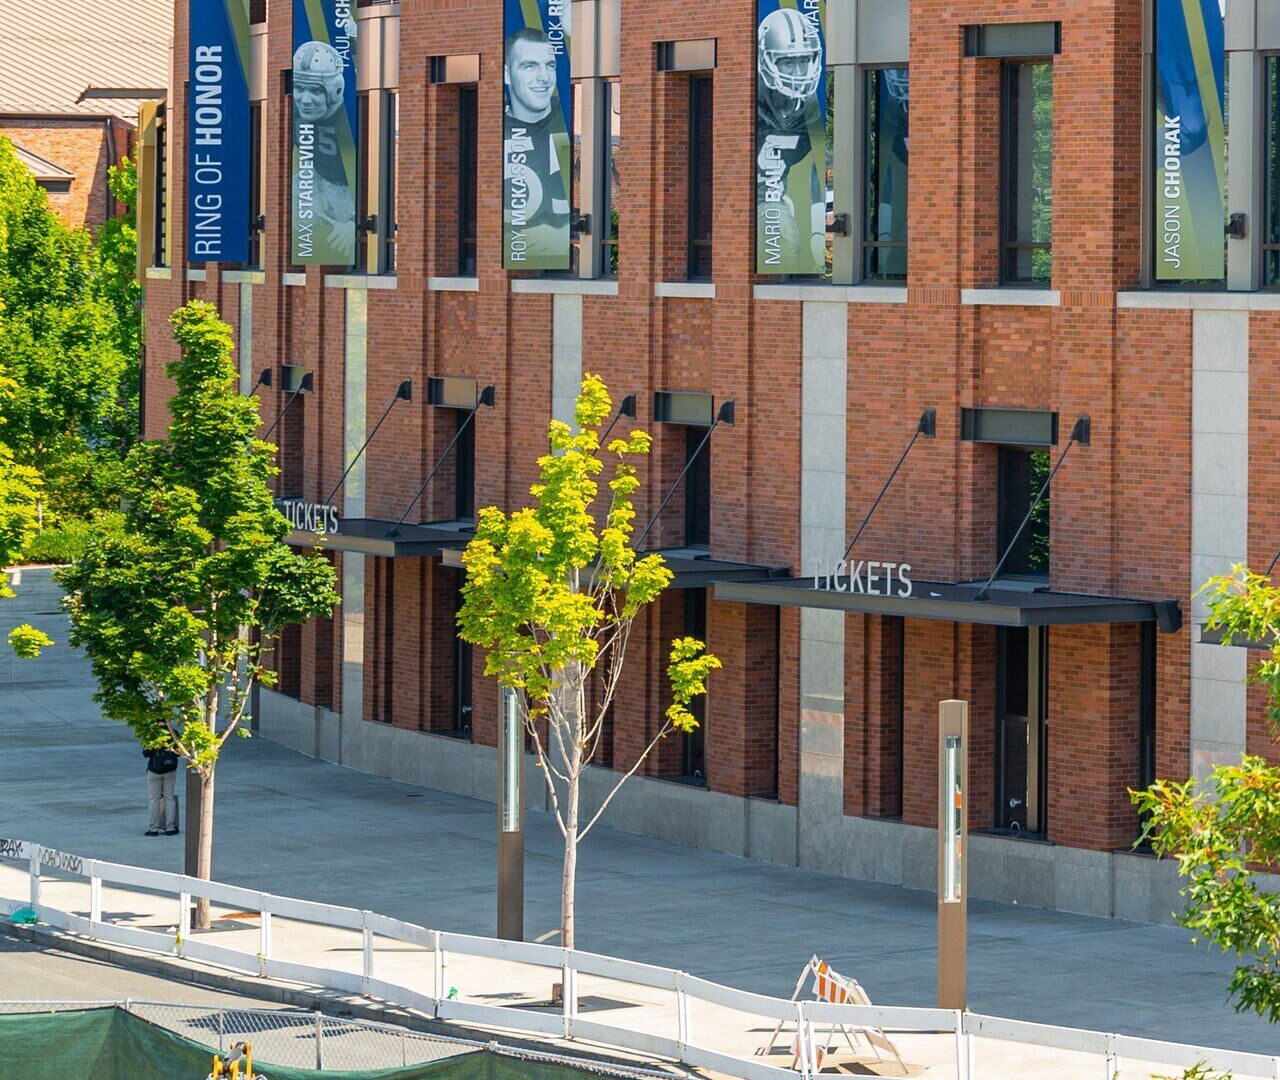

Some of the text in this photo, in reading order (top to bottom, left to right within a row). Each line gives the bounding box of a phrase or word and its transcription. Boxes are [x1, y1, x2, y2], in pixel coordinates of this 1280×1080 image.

[336, 35, 350, 67] PAUL
[548, 21, 564, 55] RICK
[195, 46, 222, 254] RING OF HONOR
[298, 124, 314, 257] MAX STARCEVICH
[511, 128, 527, 261] ROY MCKASSON
[765, 140, 781, 265] MARIO BAILEY
[1164, 115, 1181, 268] JASON CHORAK
[283, 501, 338, 534] TICKETS
[811, 559, 913, 598] TICKETS
